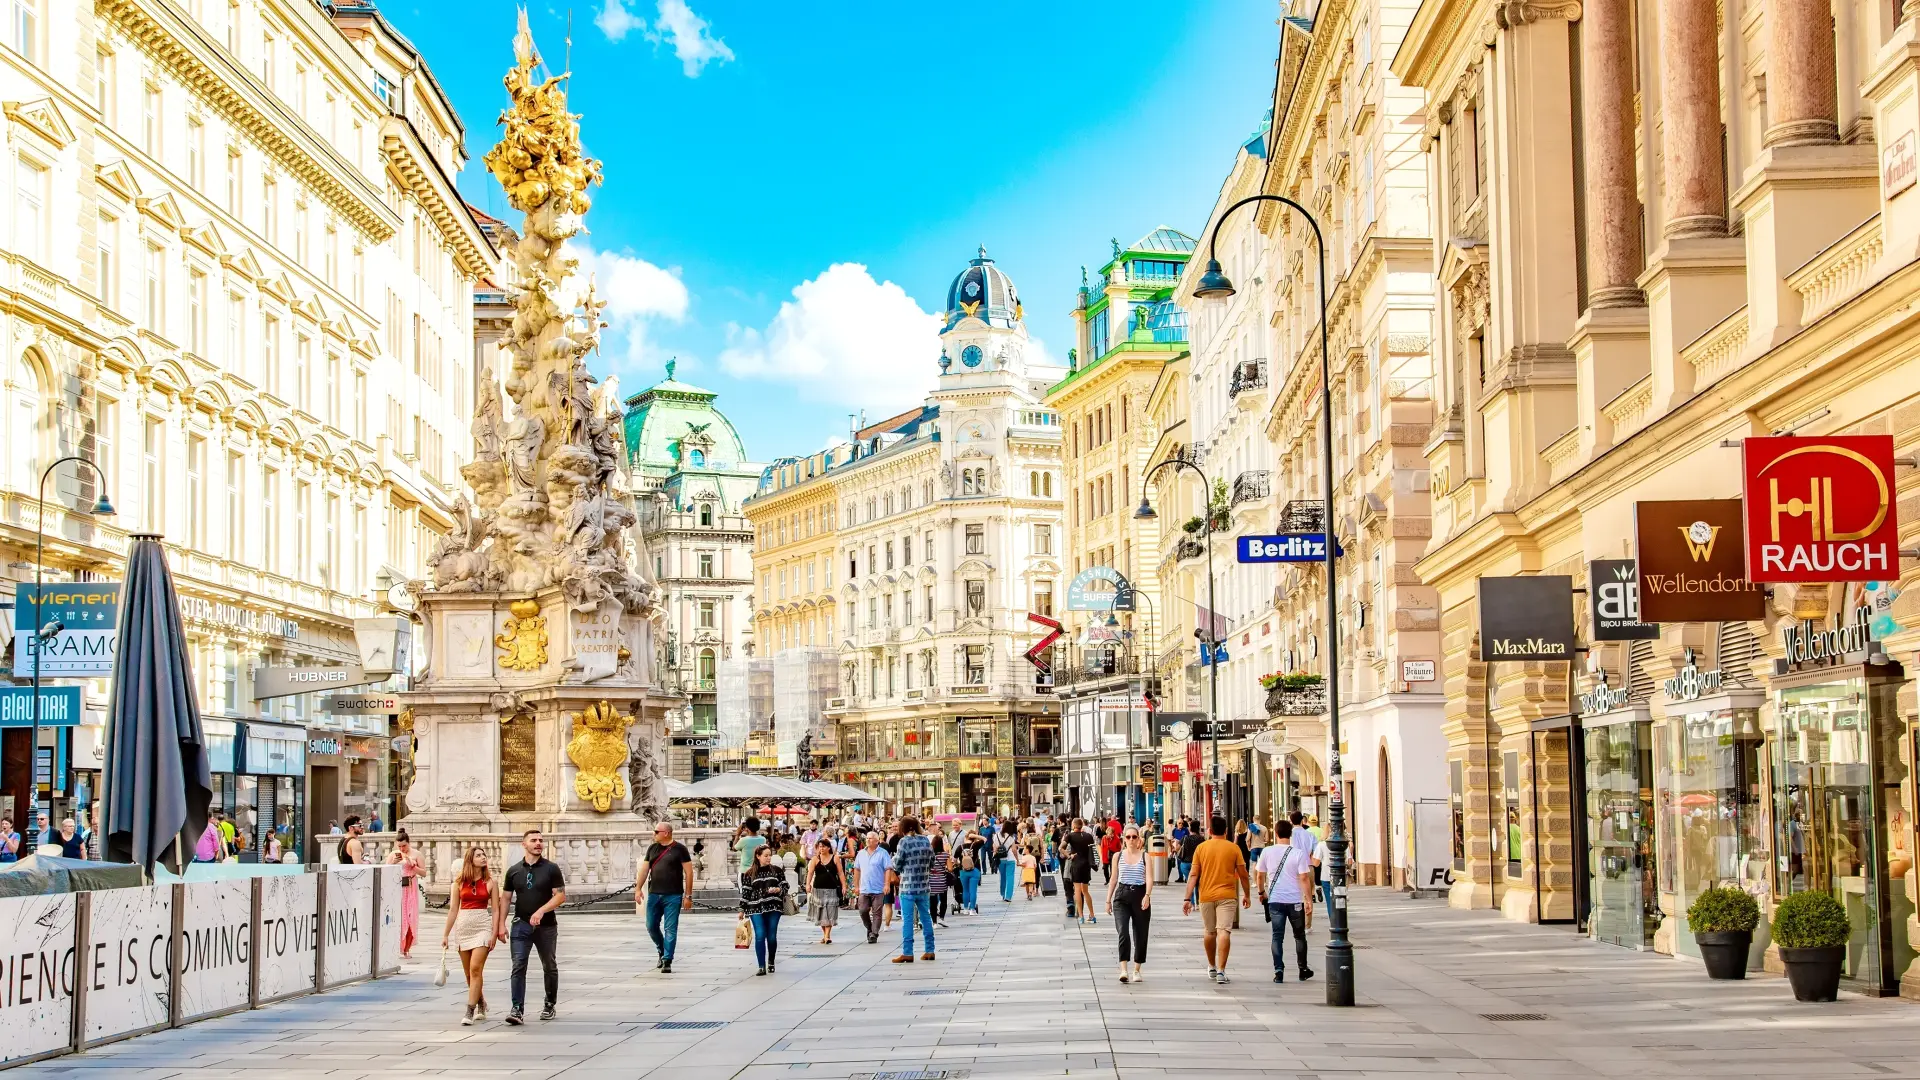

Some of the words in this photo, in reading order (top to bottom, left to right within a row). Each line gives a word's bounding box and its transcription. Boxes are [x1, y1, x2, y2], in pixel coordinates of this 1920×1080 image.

[1249, 537, 1325, 557] Berlitz
[1762, 542, 1888, 572] RAUCH
[28, 592, 118, 605] wieneri
[263, 611, 299, 639] HÜBNER
[579, 612, 610, 624] DEO
[576, 629, 614, 639] PATRI
[1782, 605, 1870, 665] Wellendorff
[1493, 638, 1565, 655] MaxMara
[288, 671, 347, 682] HÜBNER
[337, 699, 384, 709] swatch
[309, 738, 337, 755] swatch
[118, 938, 138, 986] IS
[149, 923, 248, 979] COMING
[264, 918, 286, 957] TO
[294, 908, 359, 953] VIENNA
